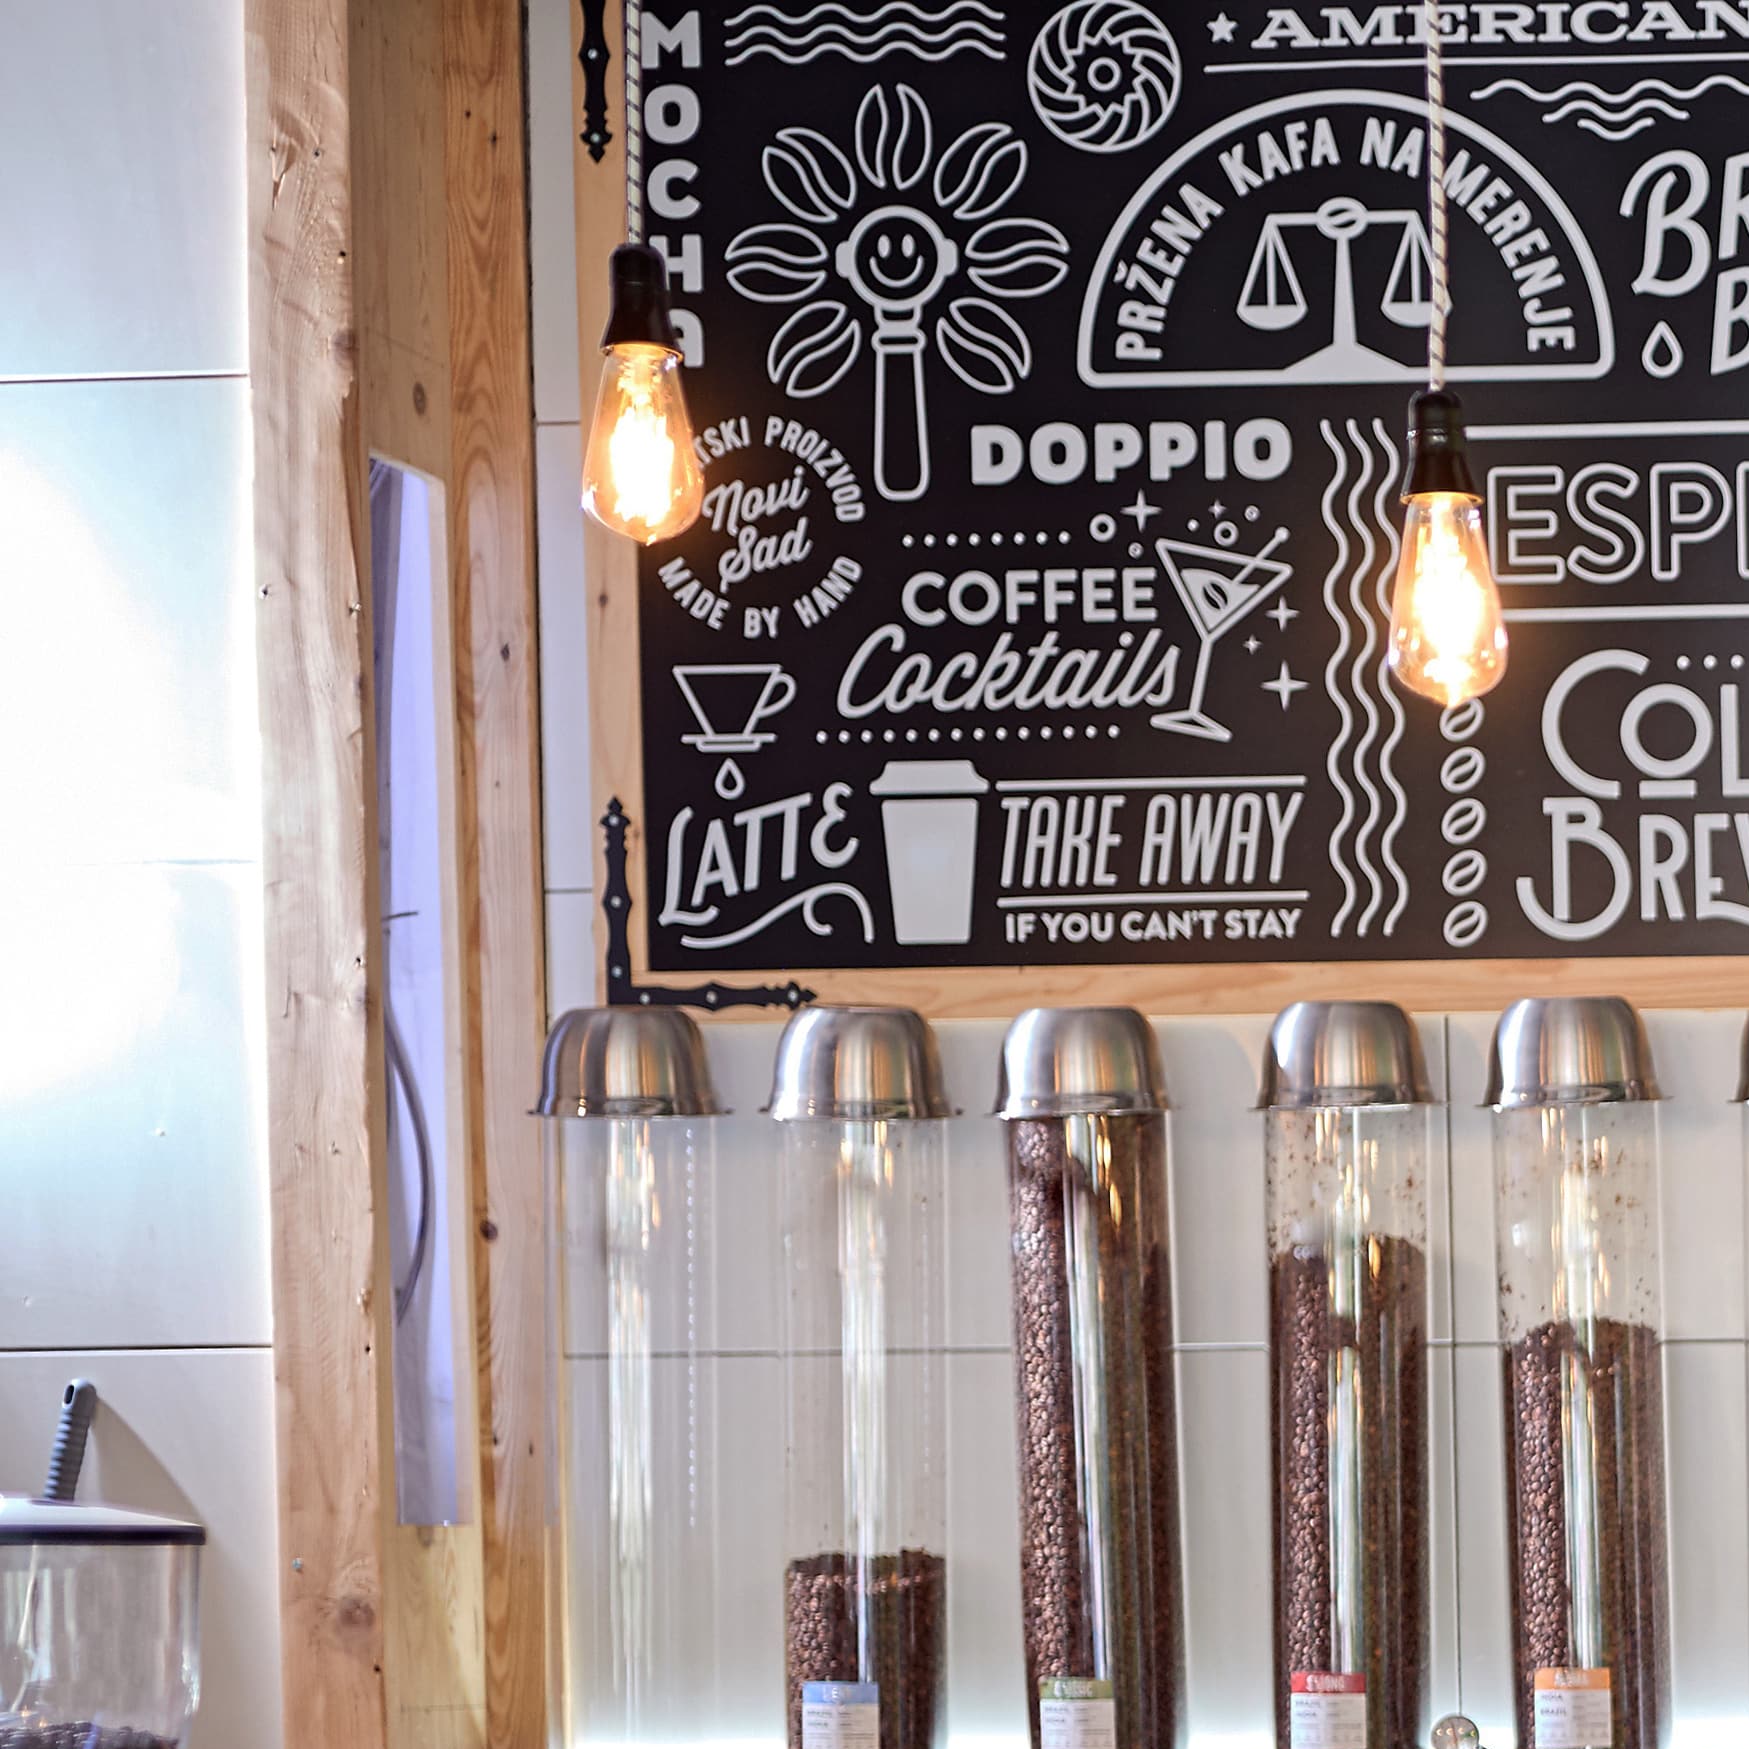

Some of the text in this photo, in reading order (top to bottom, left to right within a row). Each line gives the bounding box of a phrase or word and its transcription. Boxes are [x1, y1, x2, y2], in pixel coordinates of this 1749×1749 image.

[641, 10, 703, 368] MOCHA
[1115, 116, 1576, 361] PRŽENA KAFA NA MERENJE
[764, 415, 866, 523] PROIZVOD
[971, 418, 1294, 486] DOPPIO
[657, 555, 863, 639] MADE BY HAND
[718, 516, 813, 594] Sad
[902, 568, 1158, 627] COFFEE
[836, 623, 1183, 720] Cocktails
[658, 781, 860, 928] LATTE
[1000, 791, 1305, 888] TAKE AWAY
[1005, 907, 1303, 943] IF YOU CAN'T STAY
